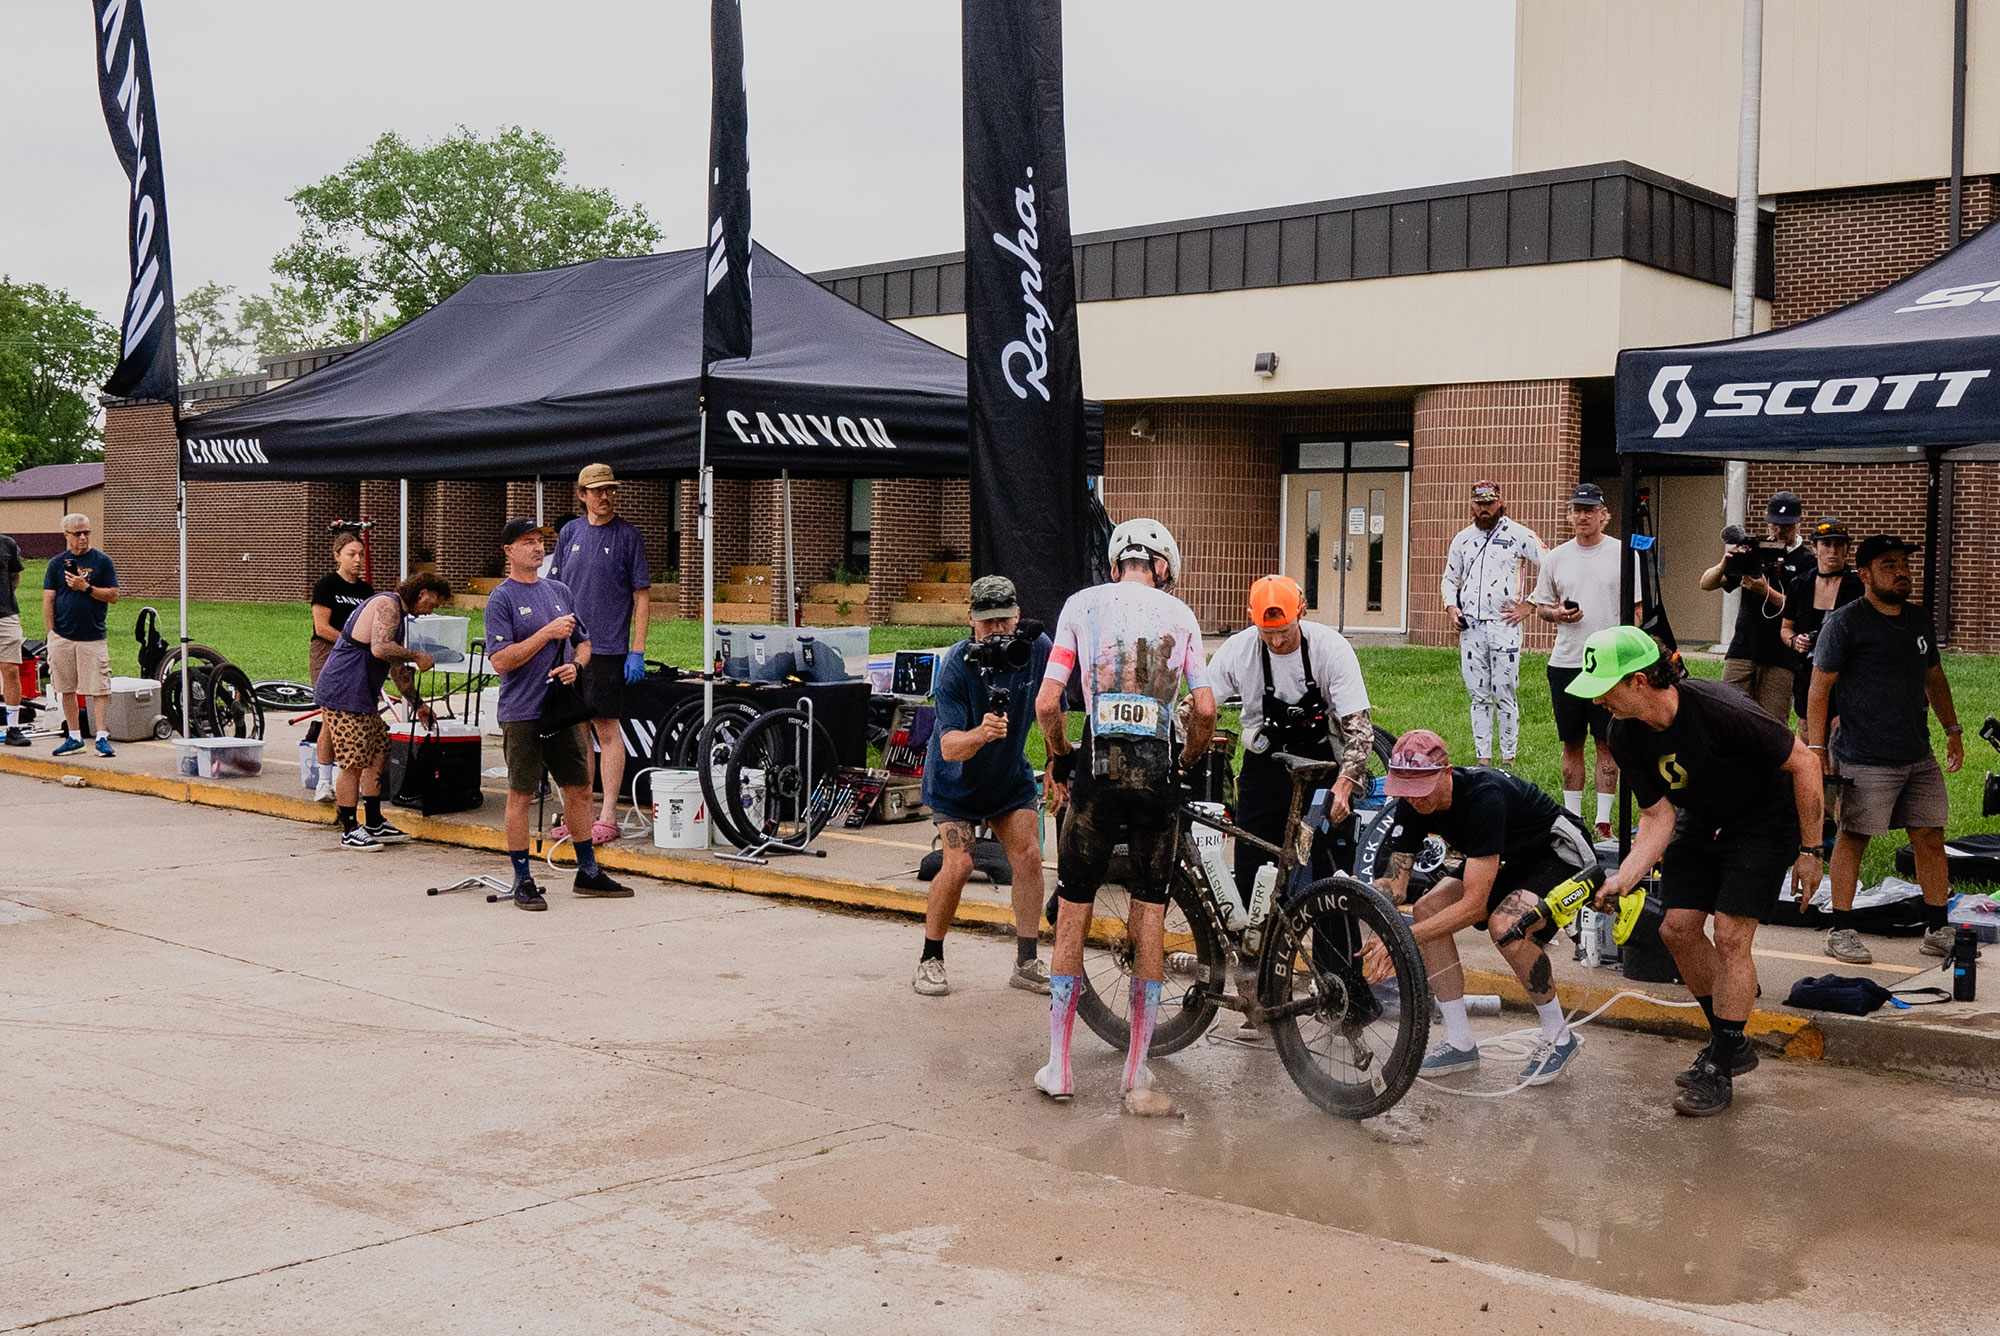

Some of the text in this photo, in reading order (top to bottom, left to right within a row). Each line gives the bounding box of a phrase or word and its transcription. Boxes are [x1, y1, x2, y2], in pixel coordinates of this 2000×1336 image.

[1895, 281, 2000, 314] S
[1704, 369, 1991, 417] SCOTT
[726, 409, 897, 449] CANYON
[186, 438, 269, 464] CANYON
[1112, 703, 1144, 723] 160
[1275, 894, 1348, 977] BLACK INC
